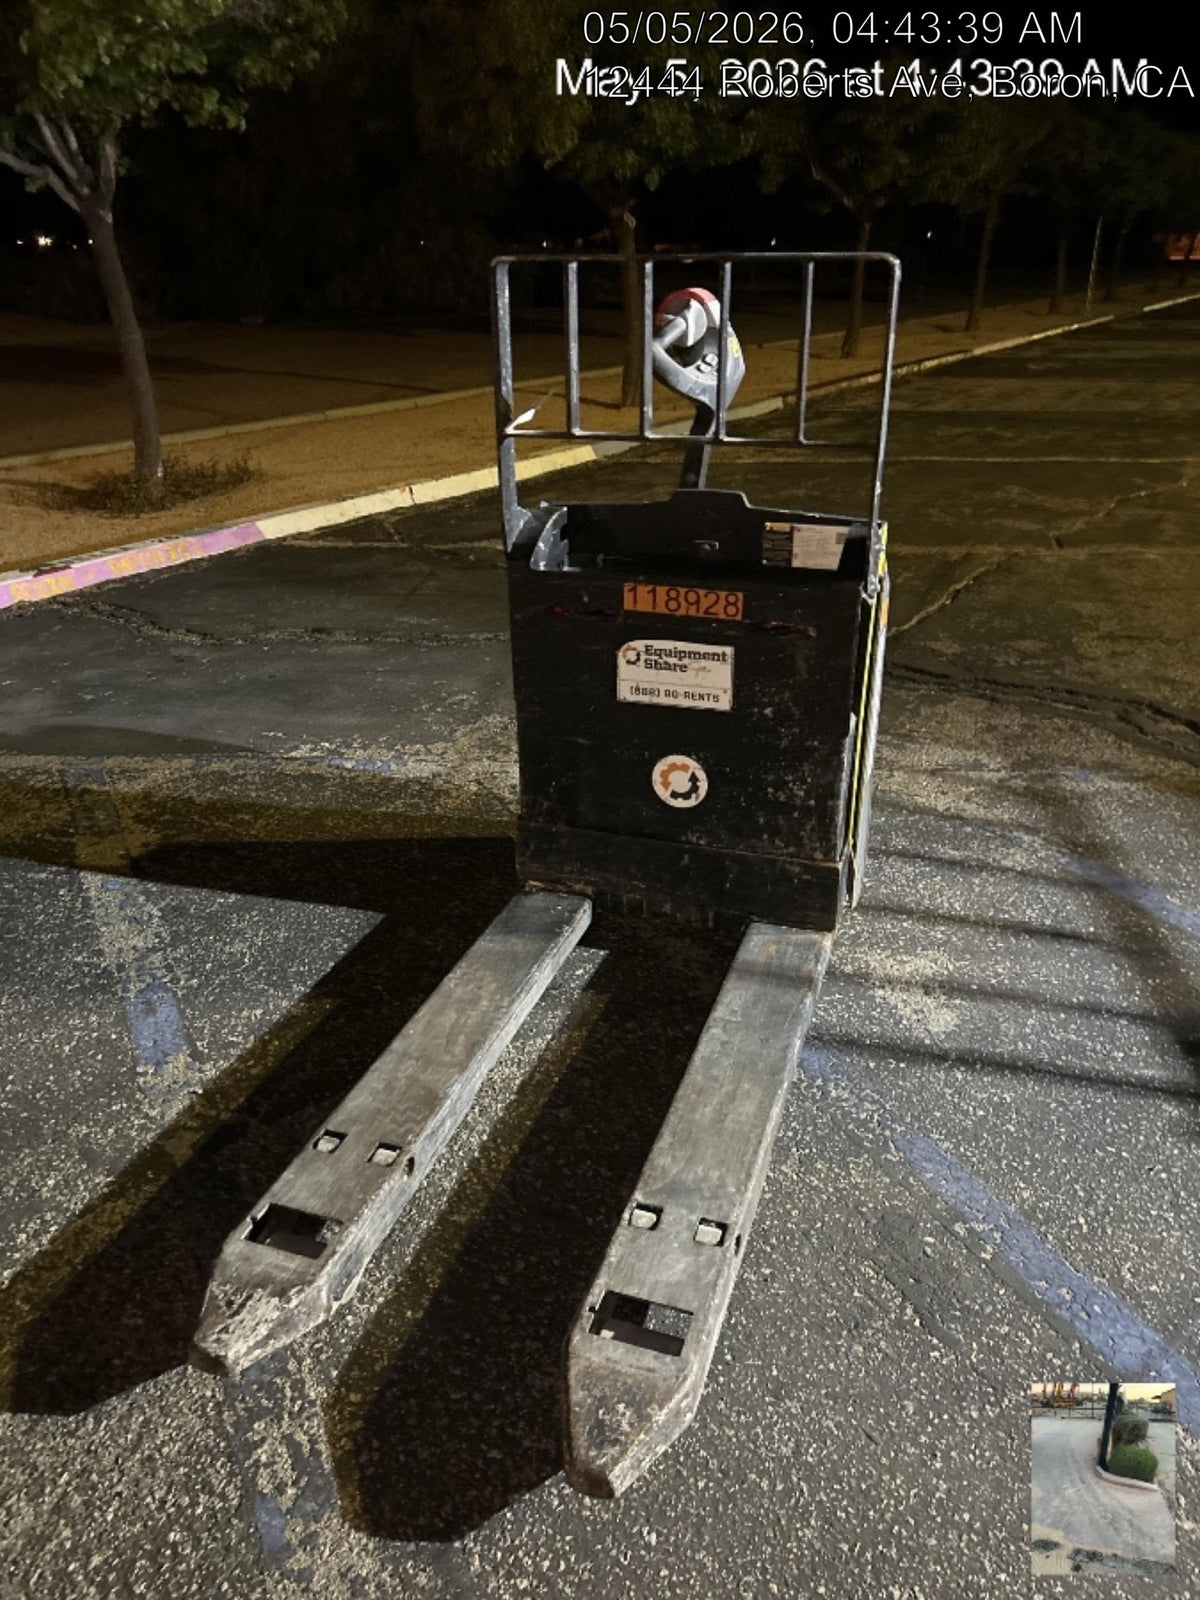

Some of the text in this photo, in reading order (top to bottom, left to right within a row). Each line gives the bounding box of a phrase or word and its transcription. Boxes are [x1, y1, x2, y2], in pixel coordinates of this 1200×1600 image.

[626, 585, 741, 619] 118928
[644, 644, 728, 662] Equipment
[644, 658, 689, 673] Share
